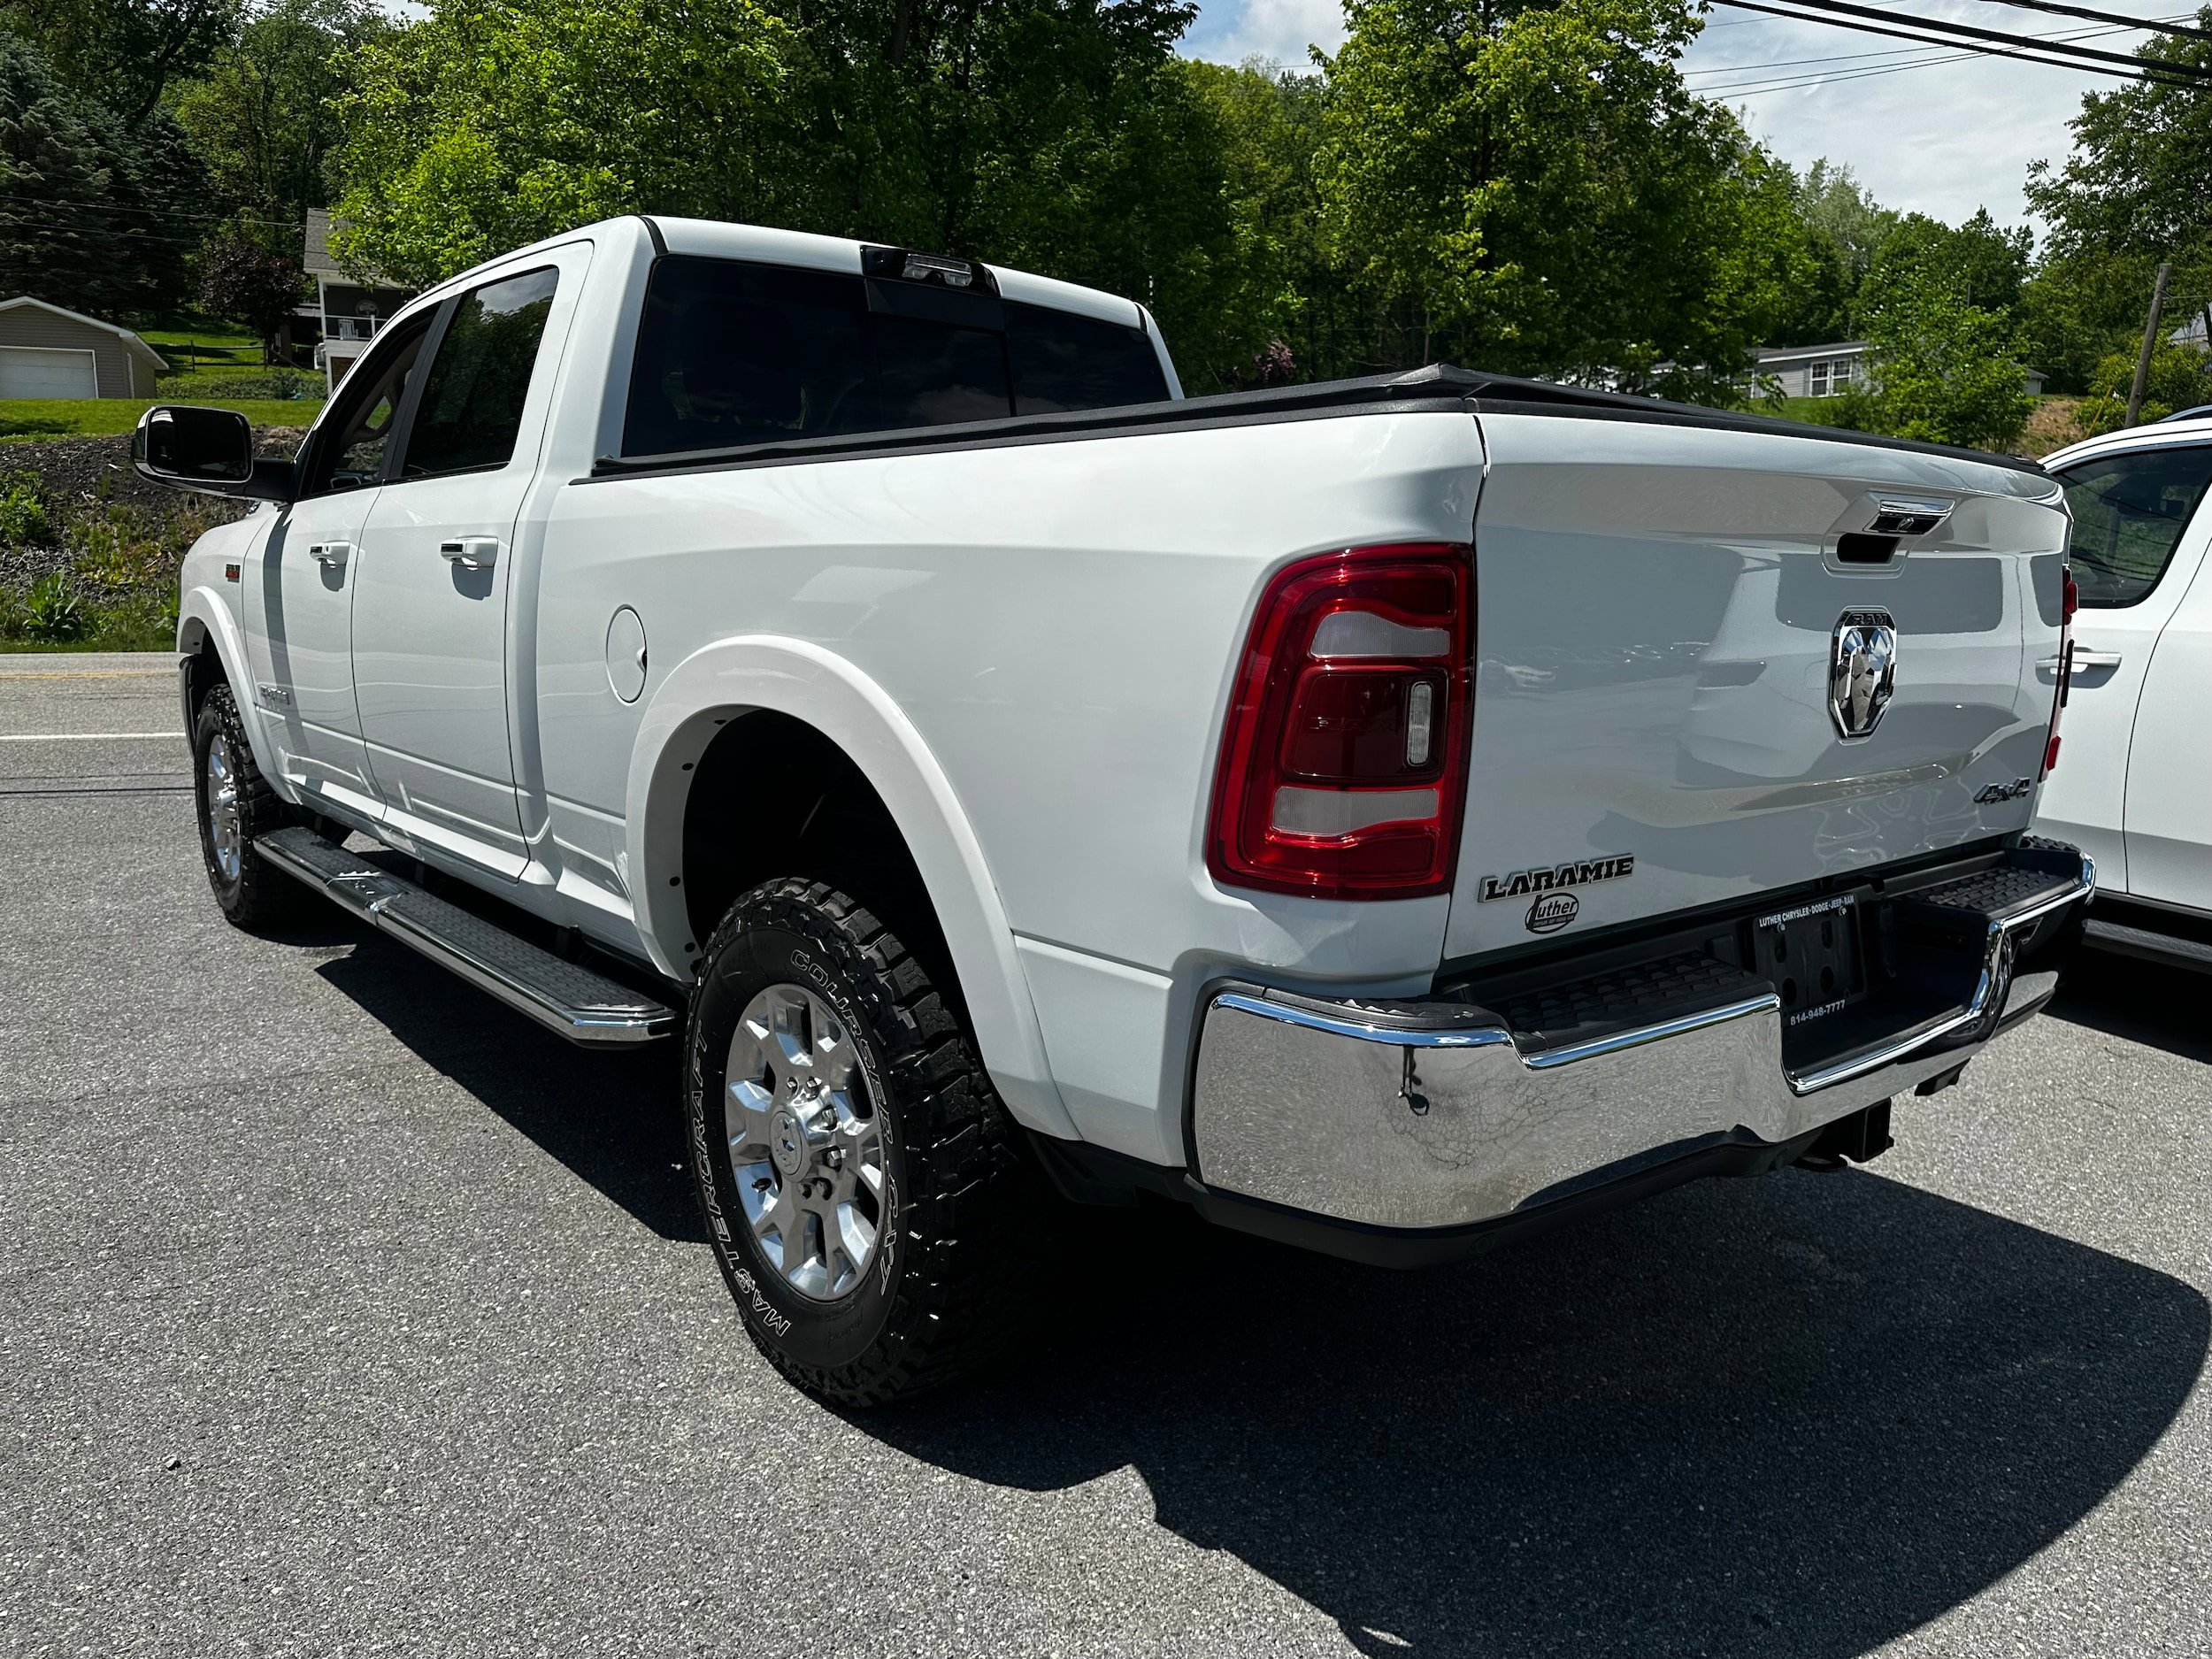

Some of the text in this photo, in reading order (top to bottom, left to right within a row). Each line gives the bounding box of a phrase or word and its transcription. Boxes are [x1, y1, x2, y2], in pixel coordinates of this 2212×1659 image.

[1852, 612, 1888, 626] RAM
[1478, 854, 1635, 902] LARAMIE
[1526, 894, 1578, 930] Luther
[1758, 913, 1782, 928] LUTHER
[1790, 999, 1847, 1026] 814-948-7777
[790, 949, 894, 1145] COURSER
[692, 1019, 791, 1338] MASTERCRAFT
